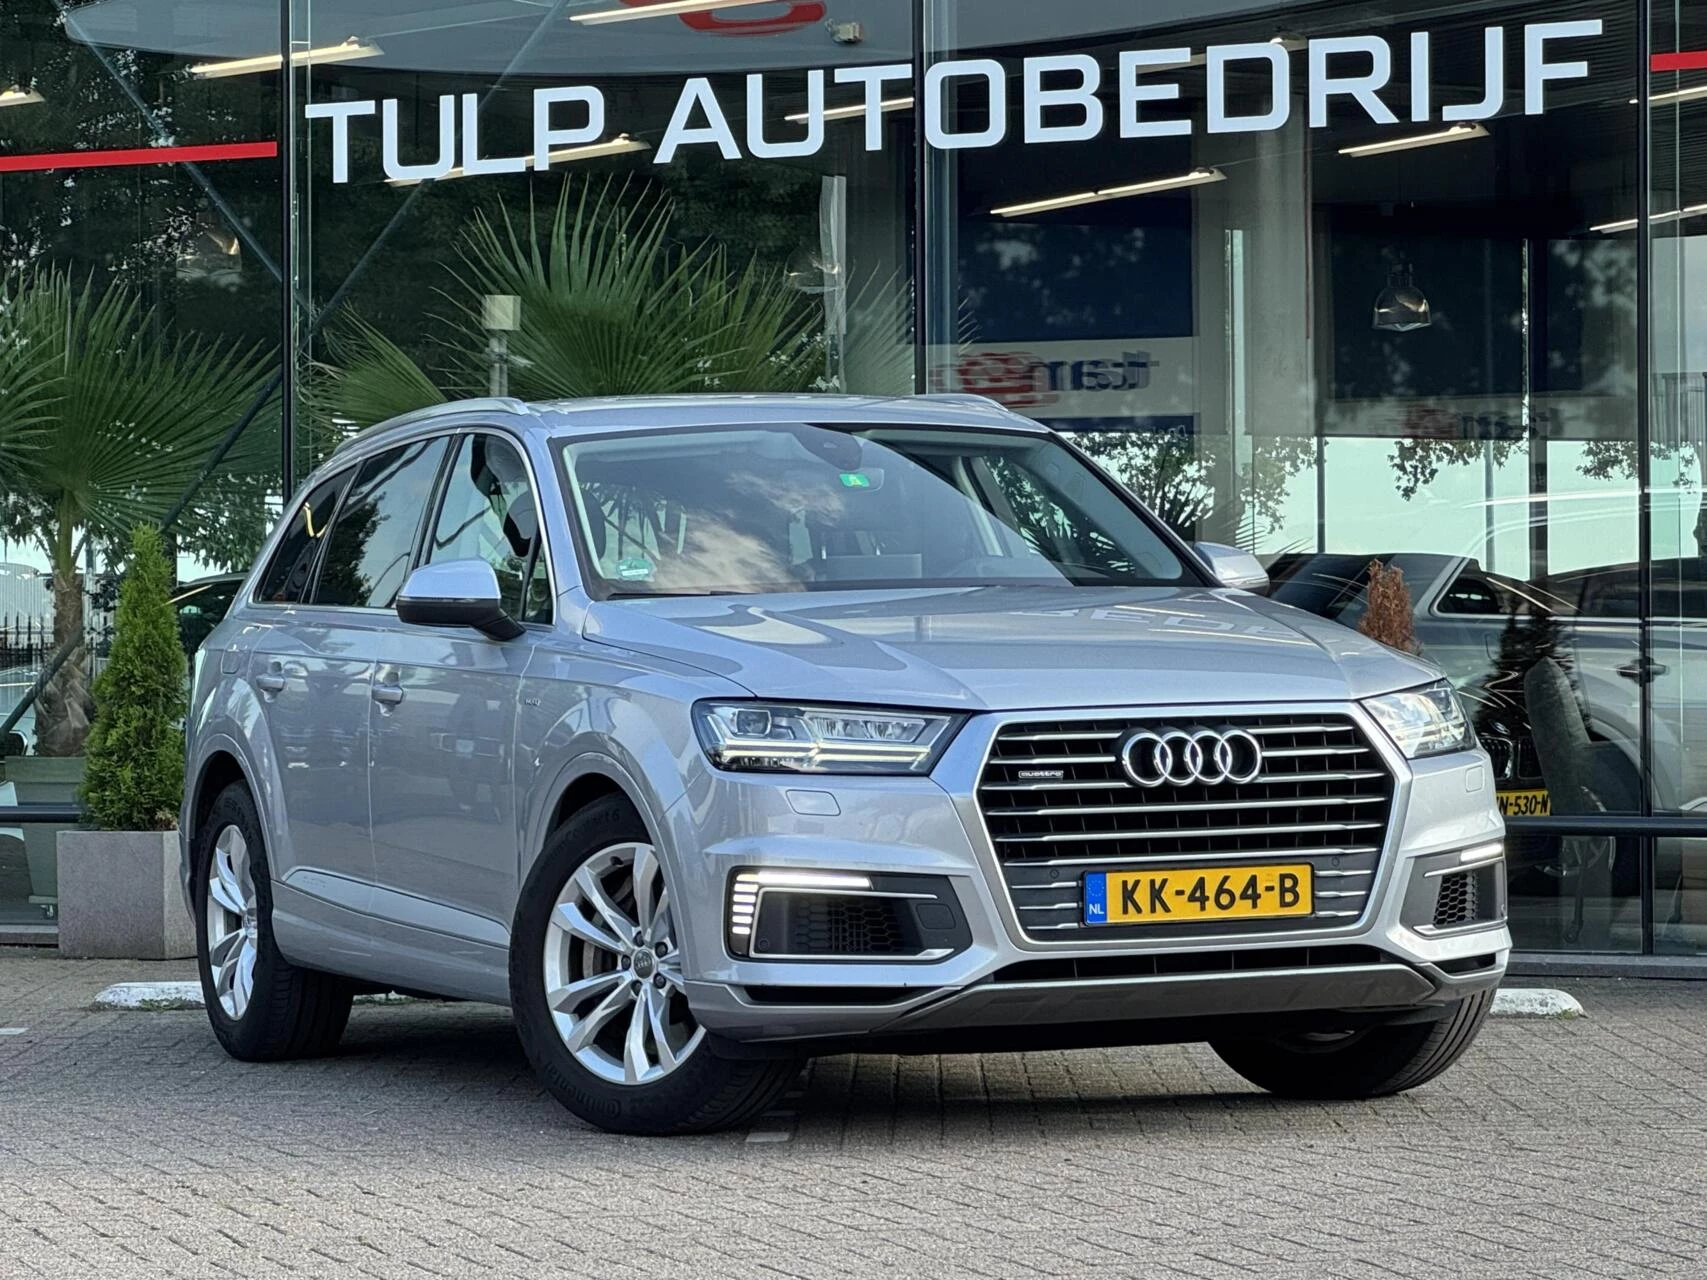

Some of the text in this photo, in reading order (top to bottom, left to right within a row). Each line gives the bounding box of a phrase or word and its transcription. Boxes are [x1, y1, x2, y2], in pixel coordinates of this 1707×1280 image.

[305, 20, 1602, 183] TULP AUTOBEDRIJF
[1497, 794, 1549, 816] N-530-N
[1121, 873, 1299, 914] KK-464-B
[1089, 904, 1104, 915] NL
